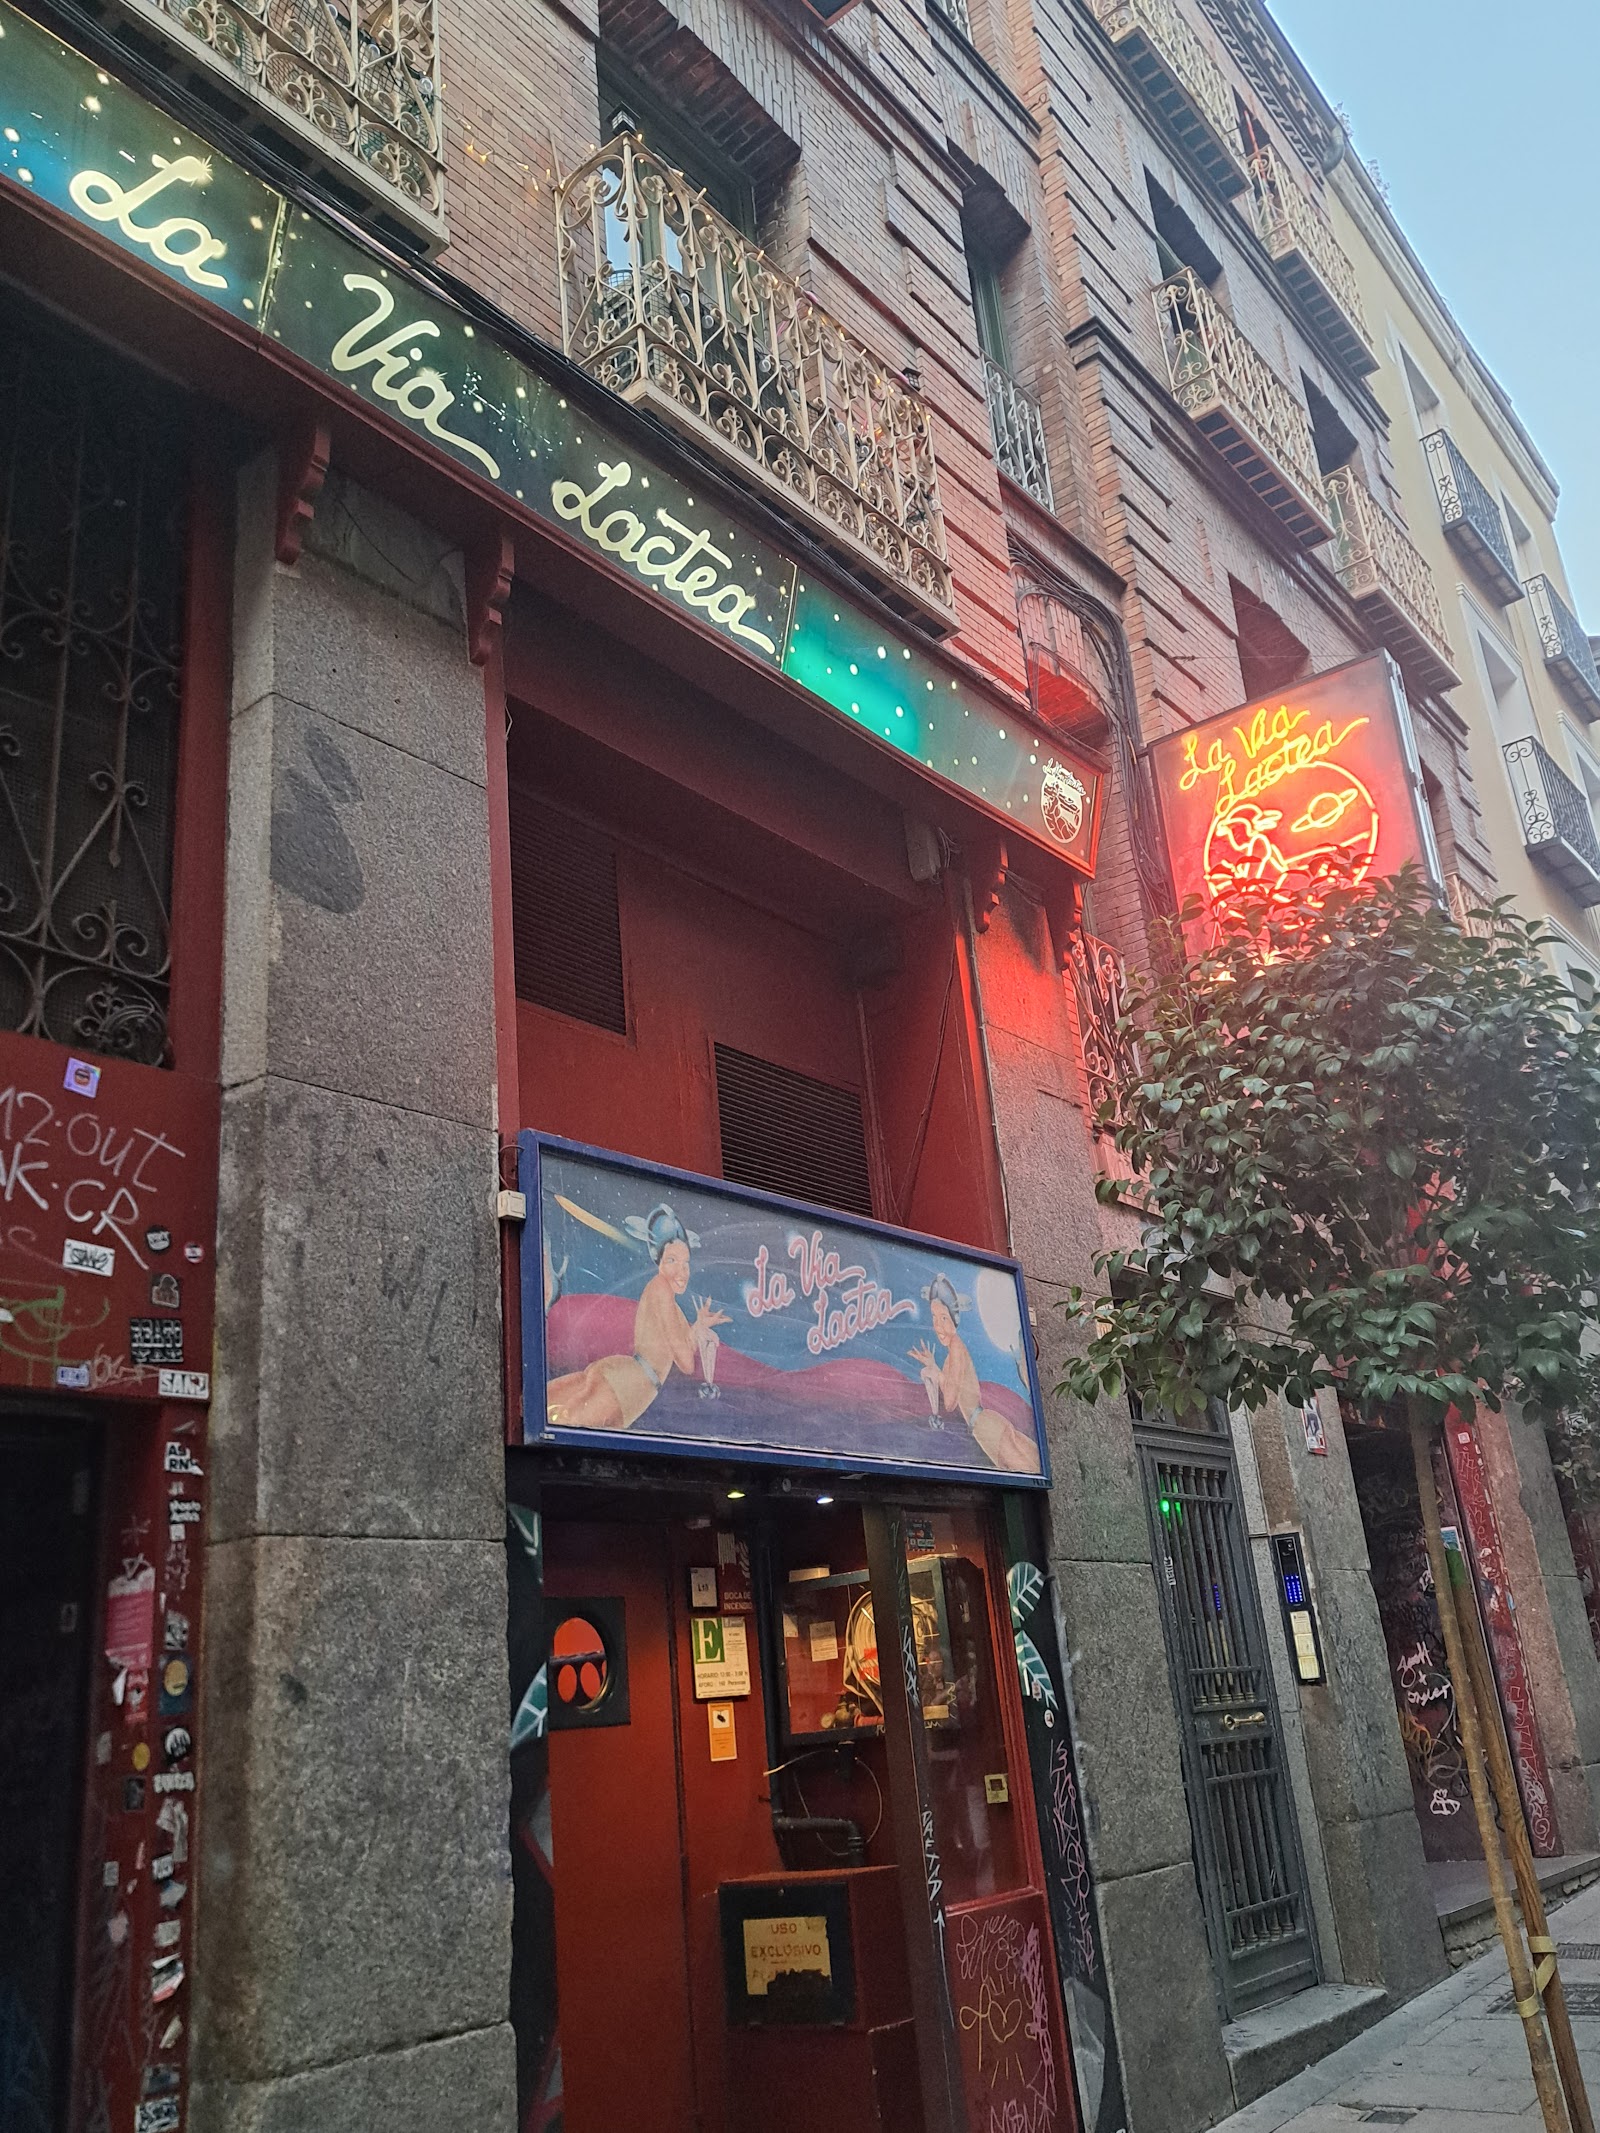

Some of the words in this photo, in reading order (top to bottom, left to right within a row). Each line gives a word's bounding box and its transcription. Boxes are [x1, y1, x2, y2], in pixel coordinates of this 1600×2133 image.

[69, 154, 228, 288] La
[331, 273, 501, 480] Via
[552, 461, 776, 655] Lactea
[1179, 730, 1231, 790] La
[1216, 716, 1370, 817] Lactea
[746, 1244, 796, 1317] La
[788, 1230, 866, 1296] Via
[807, 1278, 917, 1355] Lactea
[695, 1617, 721, 1663] E
[751, 1944, 821, 1959] EXCLUSIVO
[771, 1923, 797, 1934] USO
